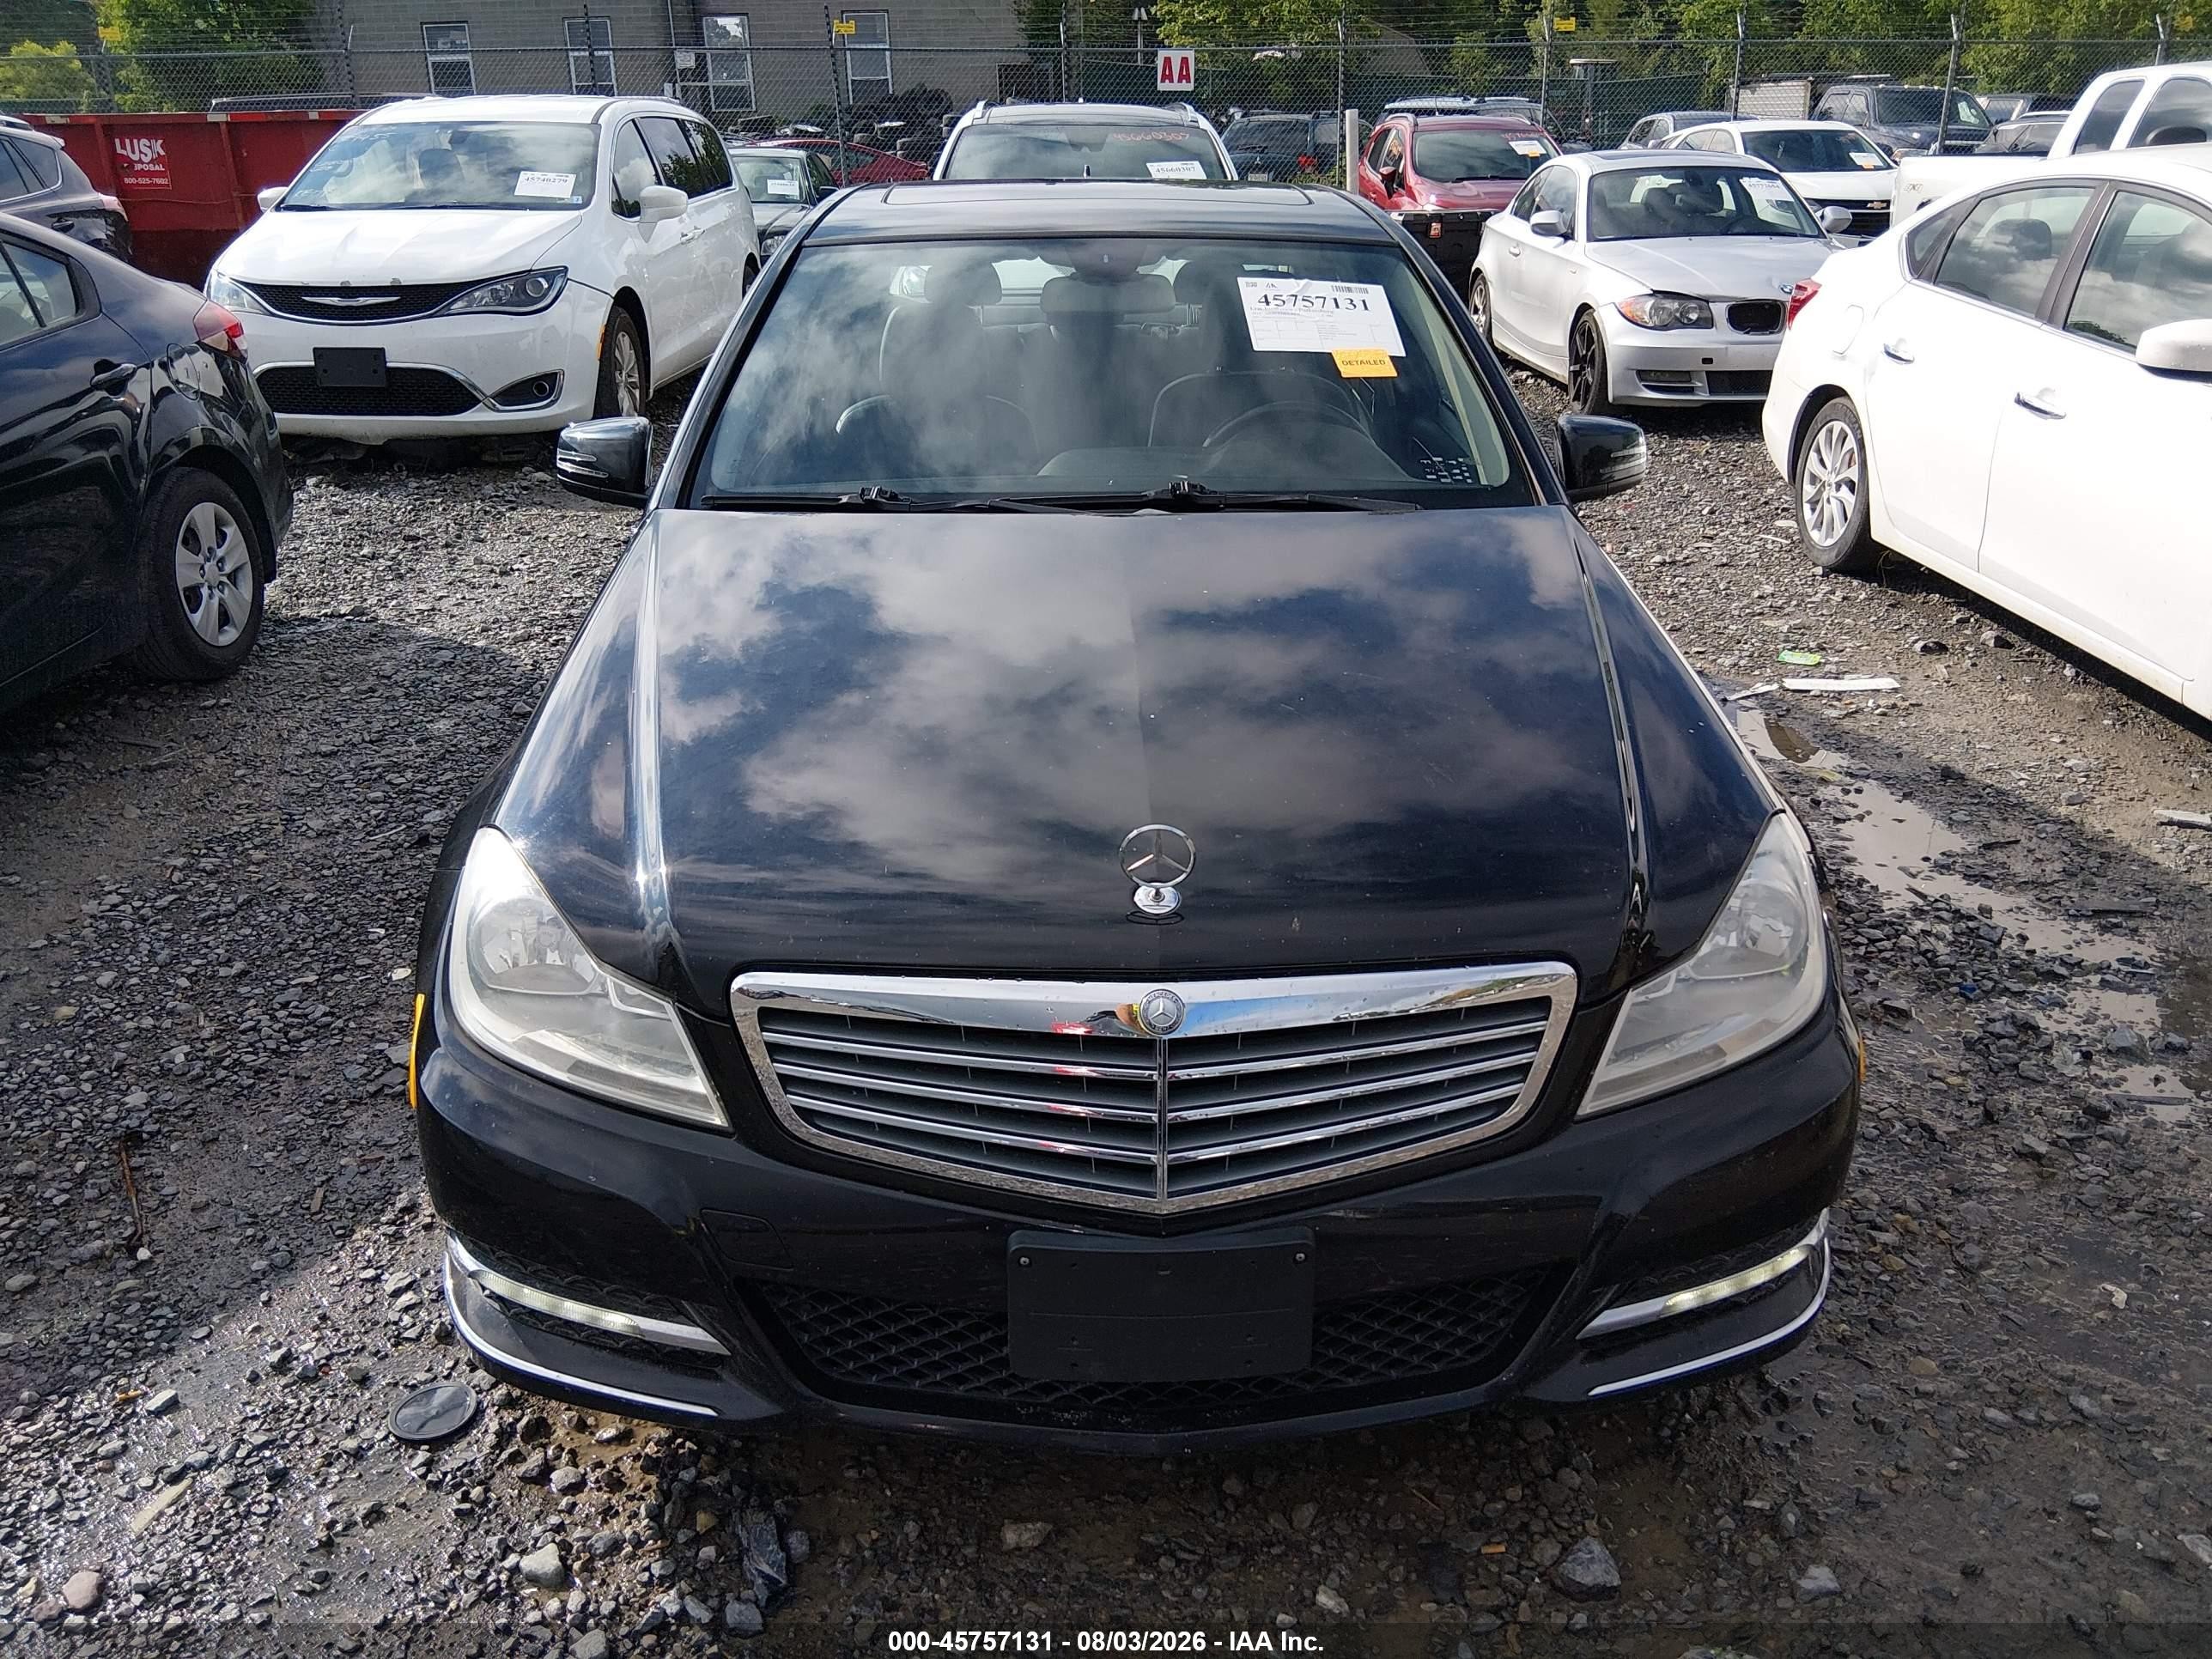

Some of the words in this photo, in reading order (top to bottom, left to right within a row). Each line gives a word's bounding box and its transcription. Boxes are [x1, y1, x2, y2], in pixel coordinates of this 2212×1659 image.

[1160, 56, 1192, 83] AA
[114, 138, 166, 163] LUSK
[1257, 293, 1370, 312] 45757131
